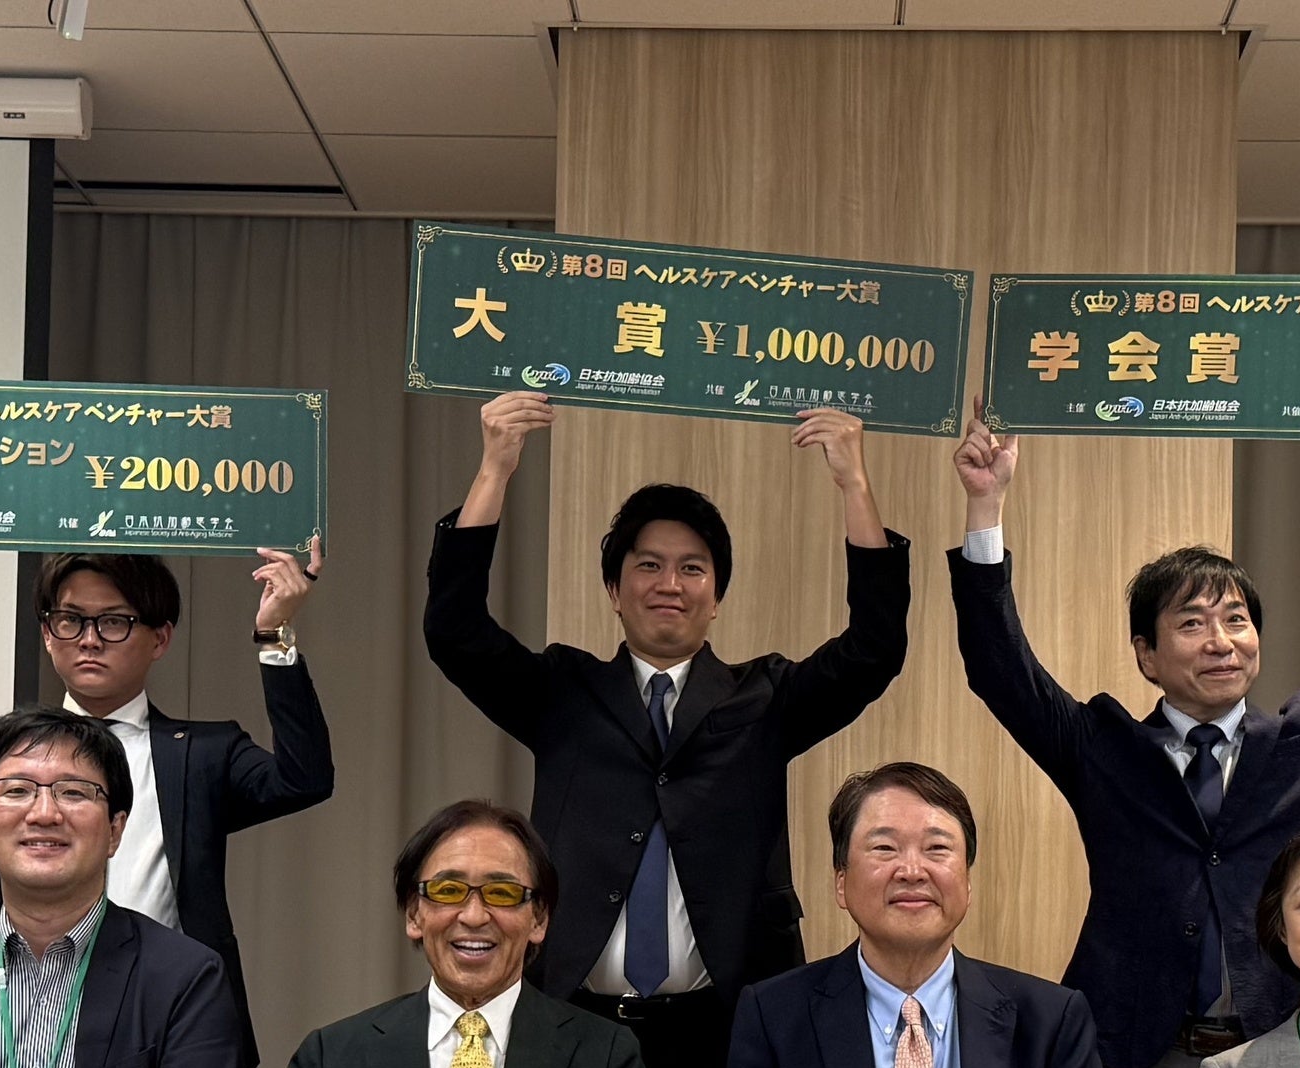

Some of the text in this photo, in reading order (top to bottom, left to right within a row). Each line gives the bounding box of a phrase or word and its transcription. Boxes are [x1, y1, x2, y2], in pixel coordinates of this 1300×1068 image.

[561, 253, 880, 305] 第8回 ヘルスケアベンチャー大賞
[1134, 291, 1199, 314] 第8回
[453, 288, 667, 357] 大 賞
[697, 321, 936, 373] ¥1,000,000
[1028, 331, 1241, 385] 学会賞
[579, 369, 665, 386] 日本抗加齢協会
[1153, 400, 1240, 412] 日本抗加齢協会
[84, 455, 294, 498] ¥200,000
